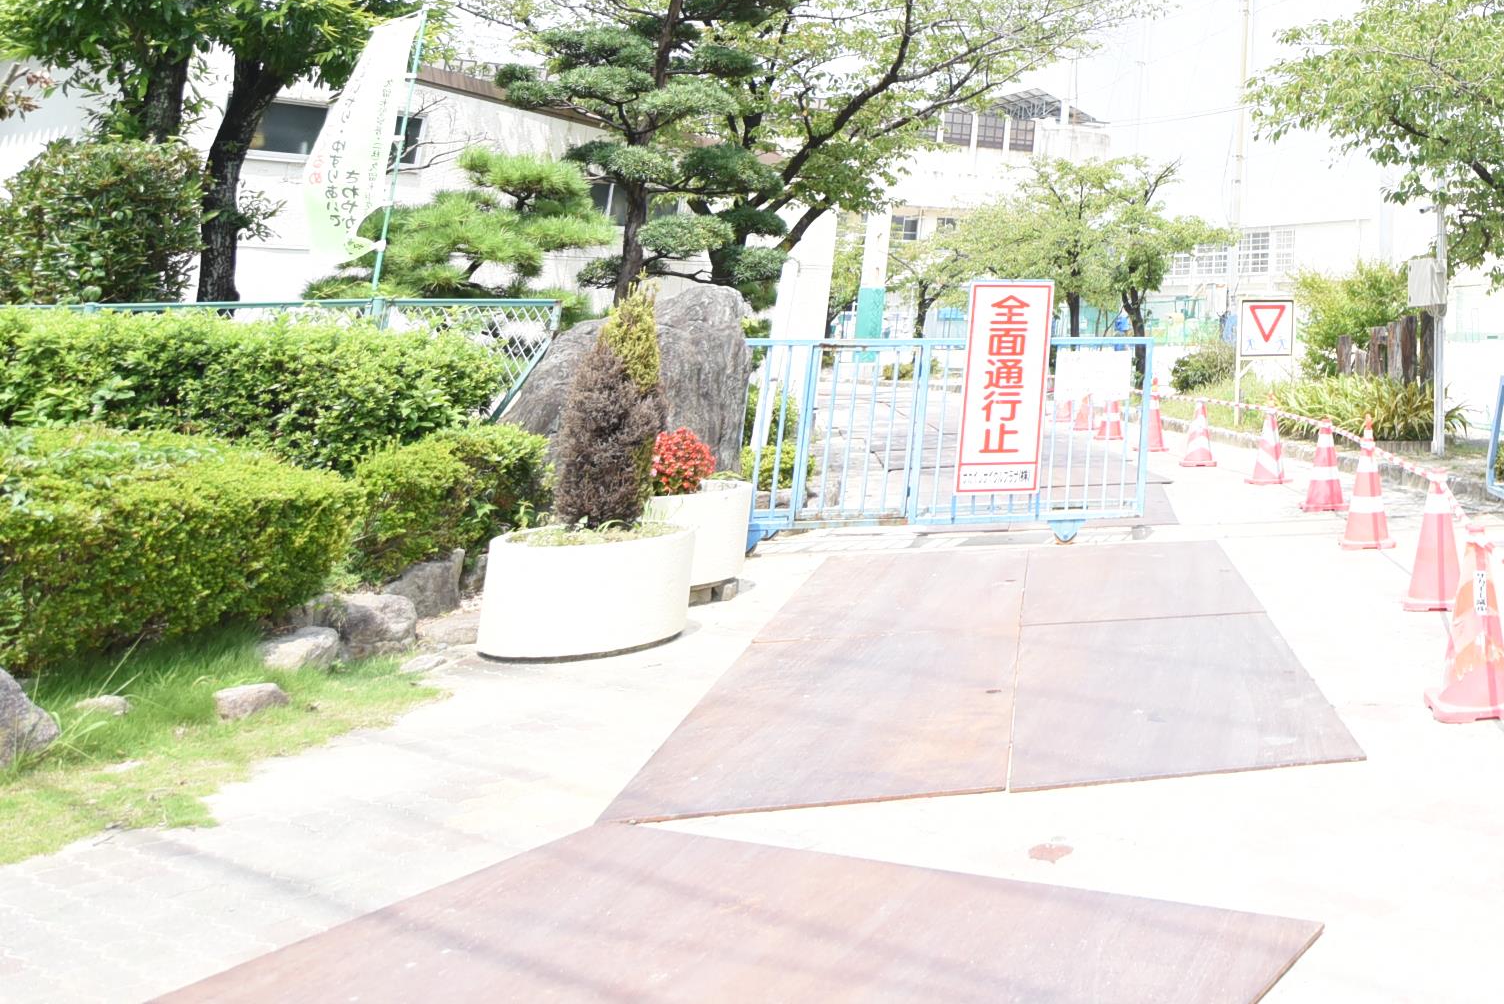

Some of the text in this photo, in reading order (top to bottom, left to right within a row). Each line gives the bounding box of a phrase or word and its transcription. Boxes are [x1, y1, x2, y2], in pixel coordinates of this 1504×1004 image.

[978, 294, 1031, 454] 全面通行止
